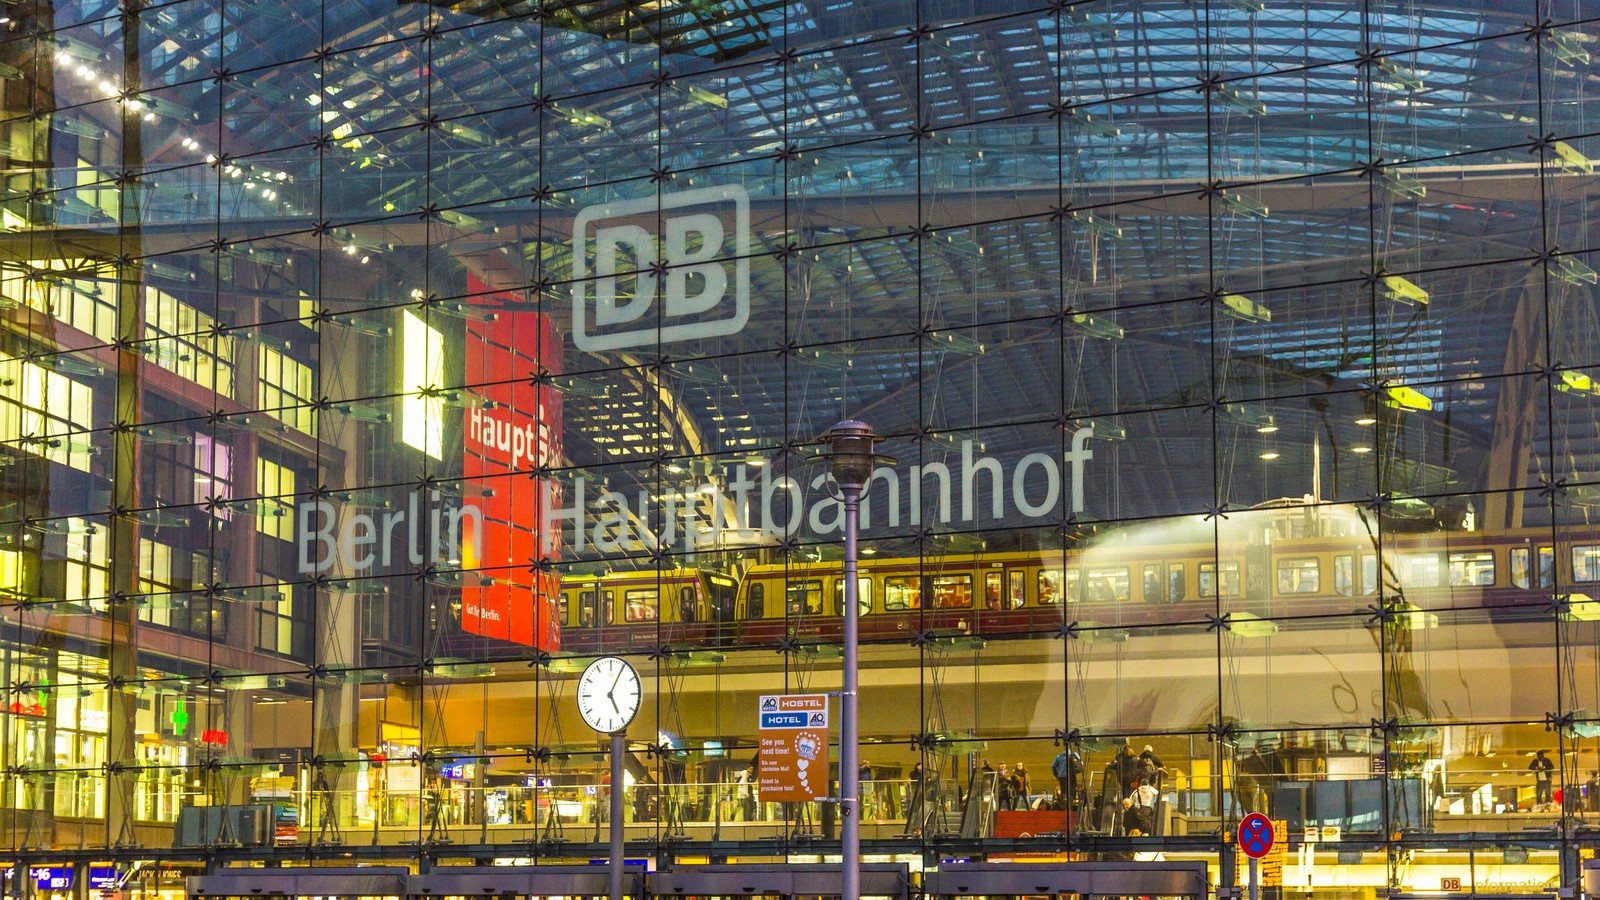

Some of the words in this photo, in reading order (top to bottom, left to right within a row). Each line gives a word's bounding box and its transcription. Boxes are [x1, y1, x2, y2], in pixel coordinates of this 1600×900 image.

[595, 213, 728, 327] DB
[299, 490, 482, 573] Berlin
[481, 608, 500, 621] Berlin.
[774, 739, 785, 747] you
[774, 747, 790, 755] time!
[452, 764, 463, 777] 15
[1443, 879, 1460, 890] DB
